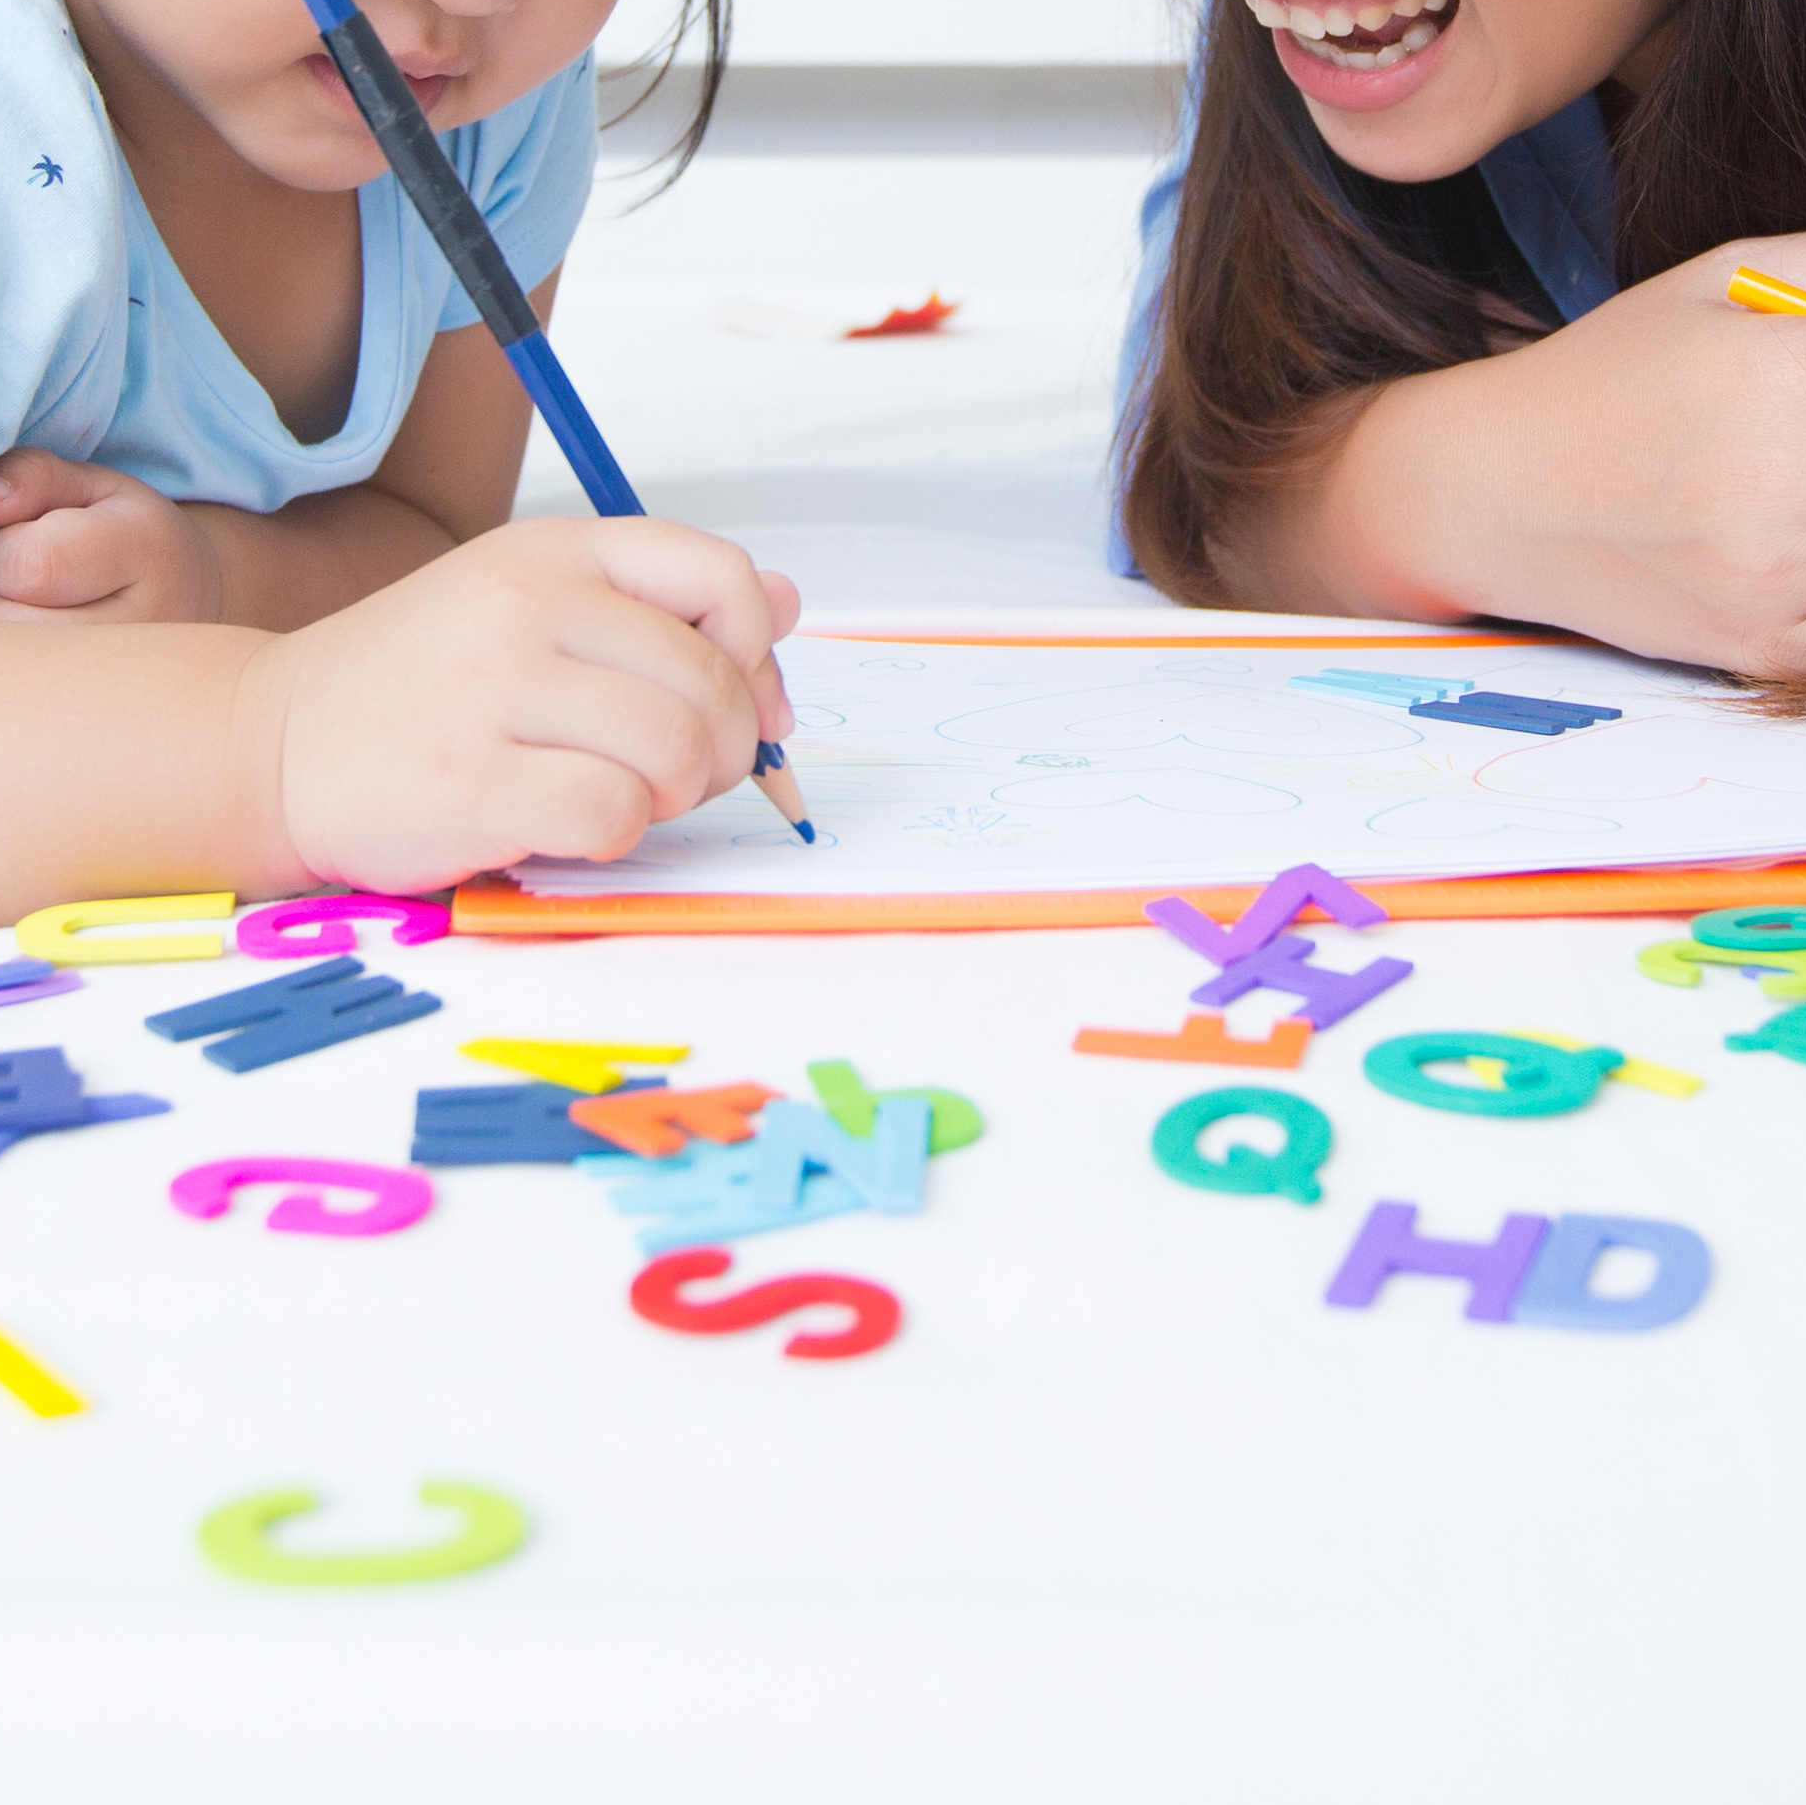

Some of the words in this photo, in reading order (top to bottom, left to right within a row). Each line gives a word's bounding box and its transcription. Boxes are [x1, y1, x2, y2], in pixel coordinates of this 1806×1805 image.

[236, 894, 452, 959] G
[1363, 1030, 1625, 1118] Q
[1151, 1086, 1334, 1206] Q
[629, 1243, 904, 1360] S
[1324, 1199, 1552, 1323] H
[1510, 1212, 1712, 1333] D
[196, 1476, 531, 1589] C
